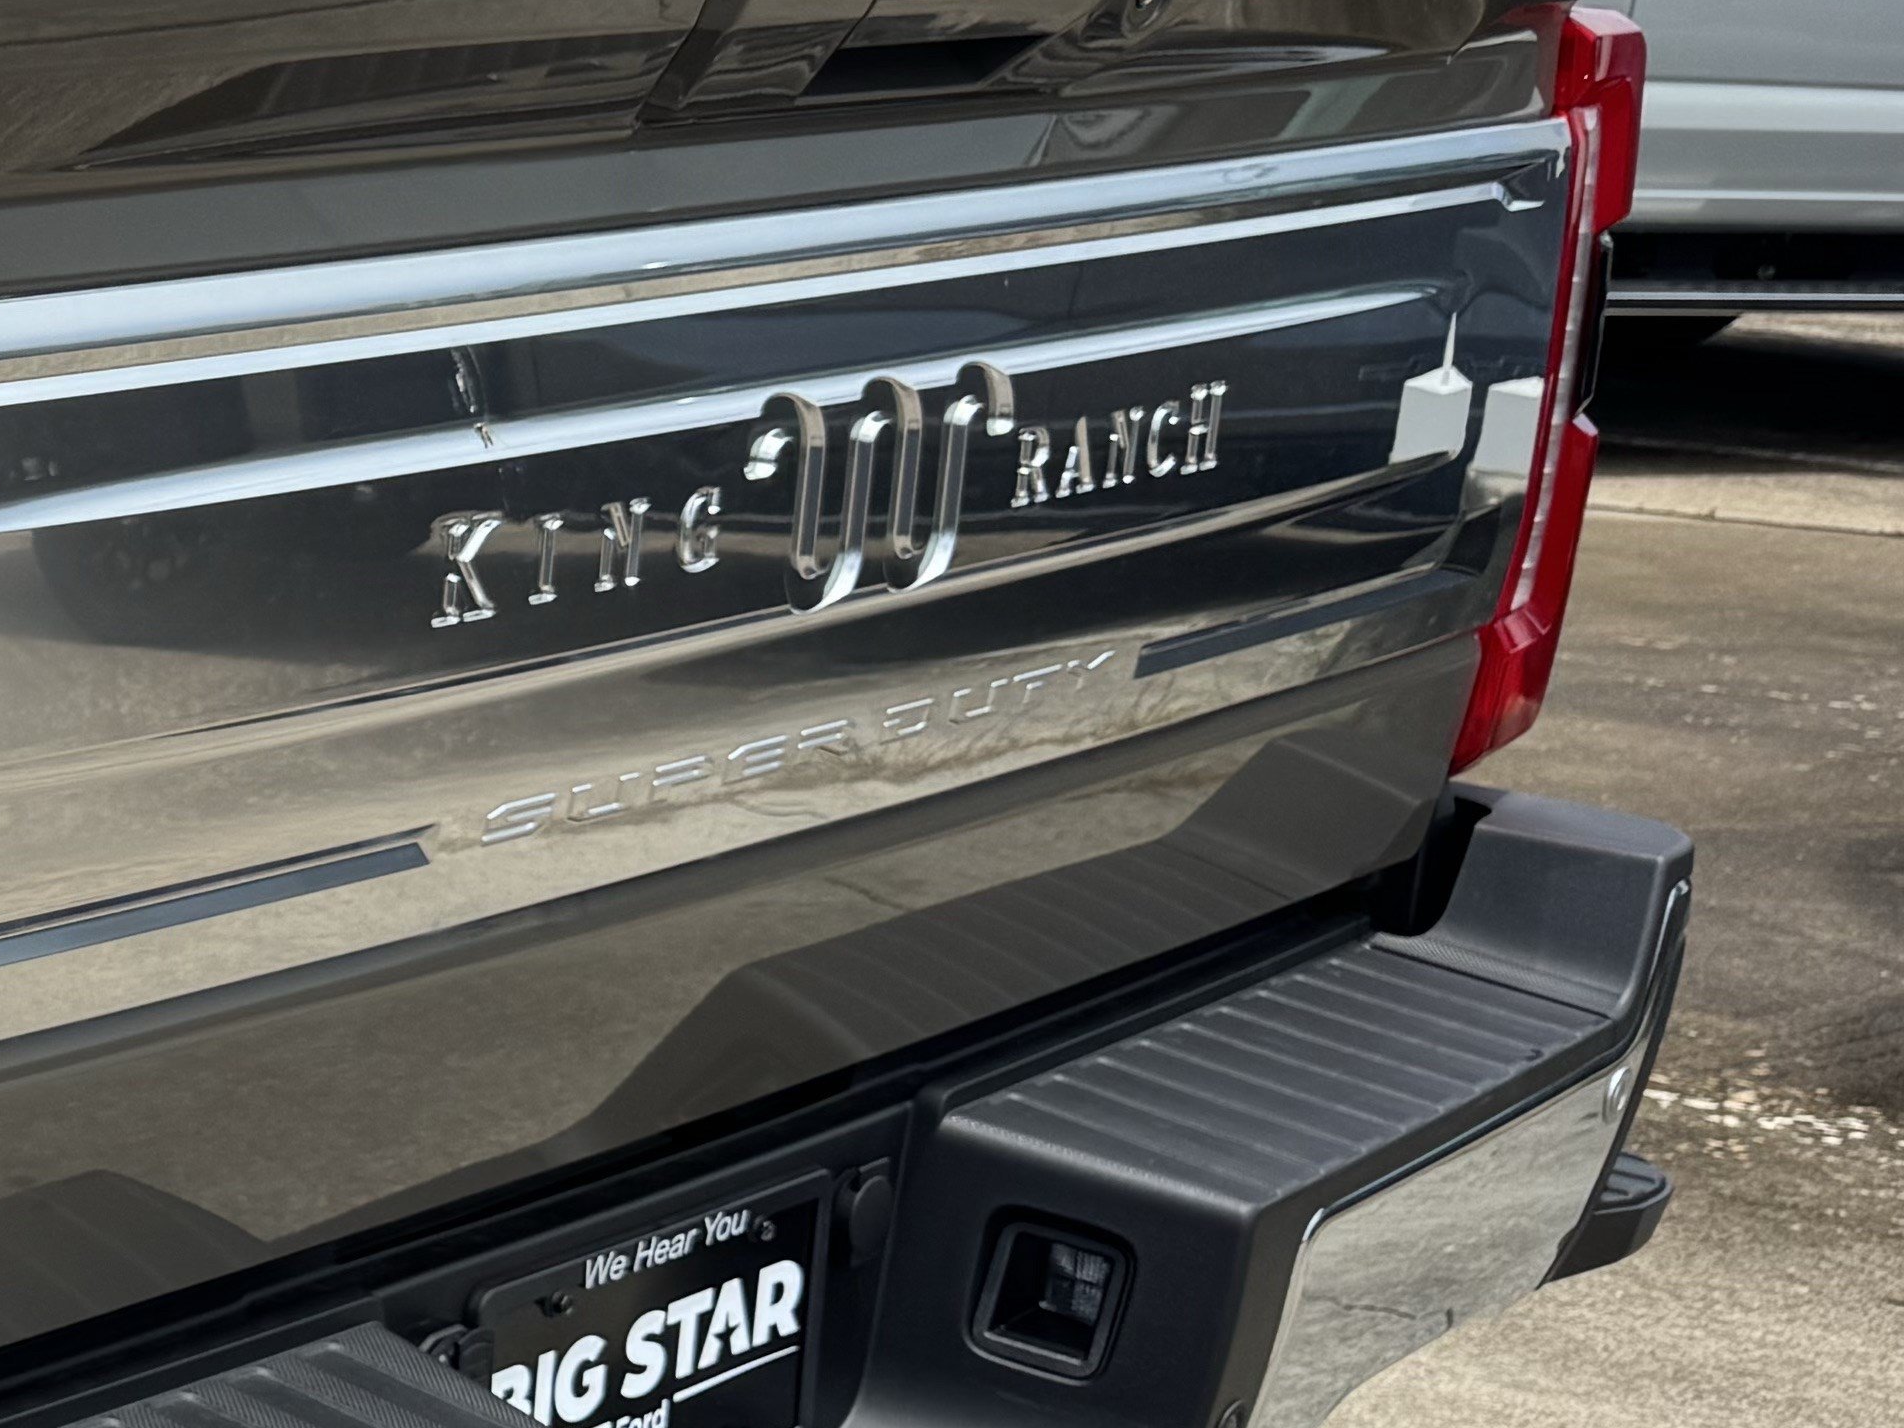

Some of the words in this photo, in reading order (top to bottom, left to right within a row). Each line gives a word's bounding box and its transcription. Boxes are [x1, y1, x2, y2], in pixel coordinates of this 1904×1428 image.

[430, 486, 722, 628] KING
[1010, 380, 1228, 508] RANCH
[480, 719, 856, 847] SUPER
[880, 650, 1116, 744] DUTY
[584, 1253, 628, 1289] We
[632, 1228, 697, 1274] Hear
[704, 1209, 750, 1246] You
[620, 1259, 805, 1399] STAR
